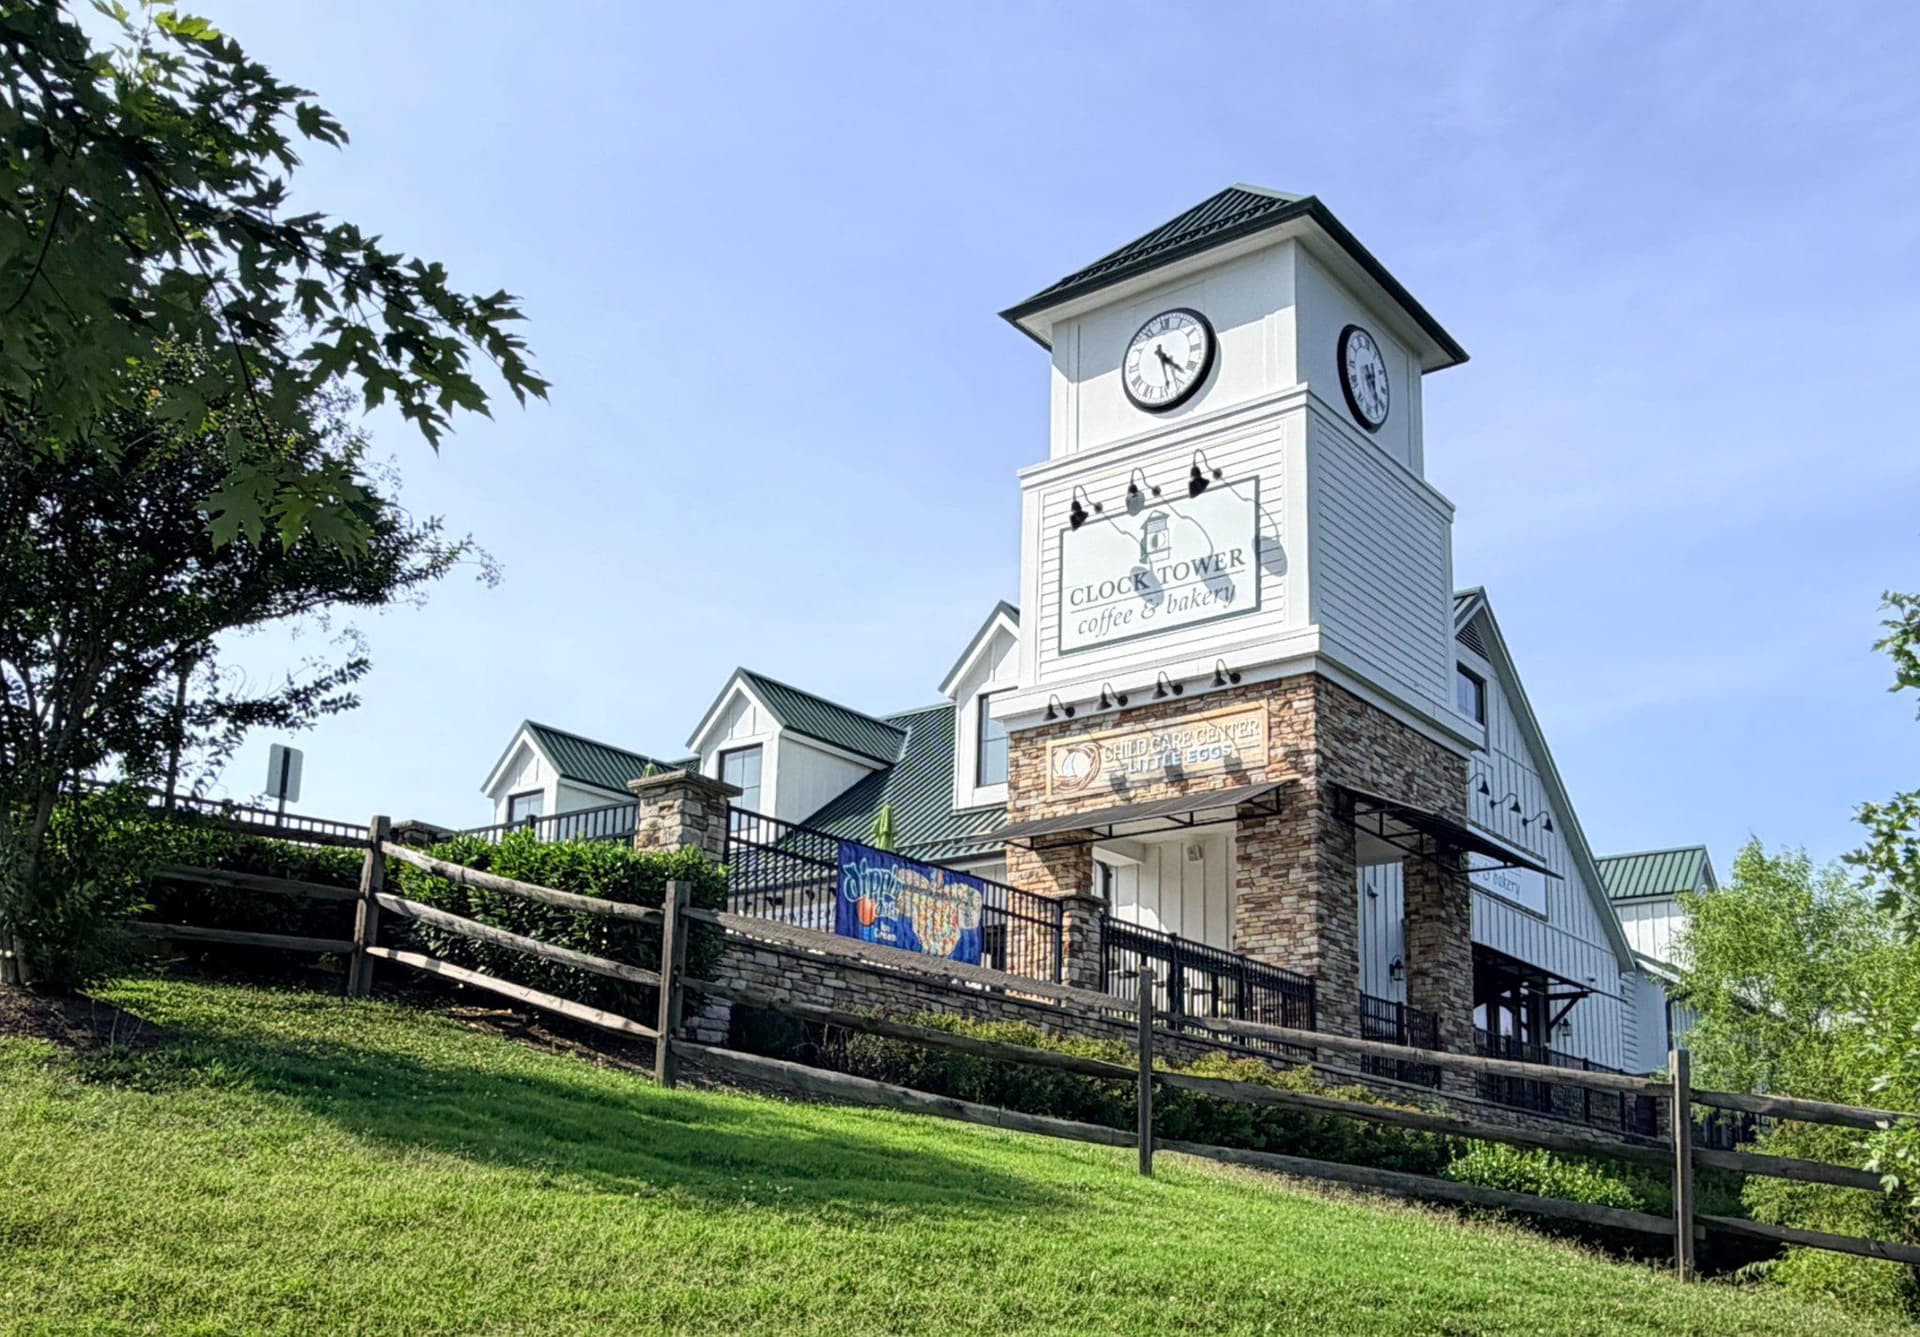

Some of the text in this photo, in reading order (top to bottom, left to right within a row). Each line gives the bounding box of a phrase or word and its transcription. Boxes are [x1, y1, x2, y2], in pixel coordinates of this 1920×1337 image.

[1070, 548, 1246, 606] CLOCK TOWER
[1078, 584, 1236, 638] coffee & bakery
[1103, 718, 1261, 763] CHILD CARE CENTER
[1127, 744, 1233, 774] LITTLE EGGS
